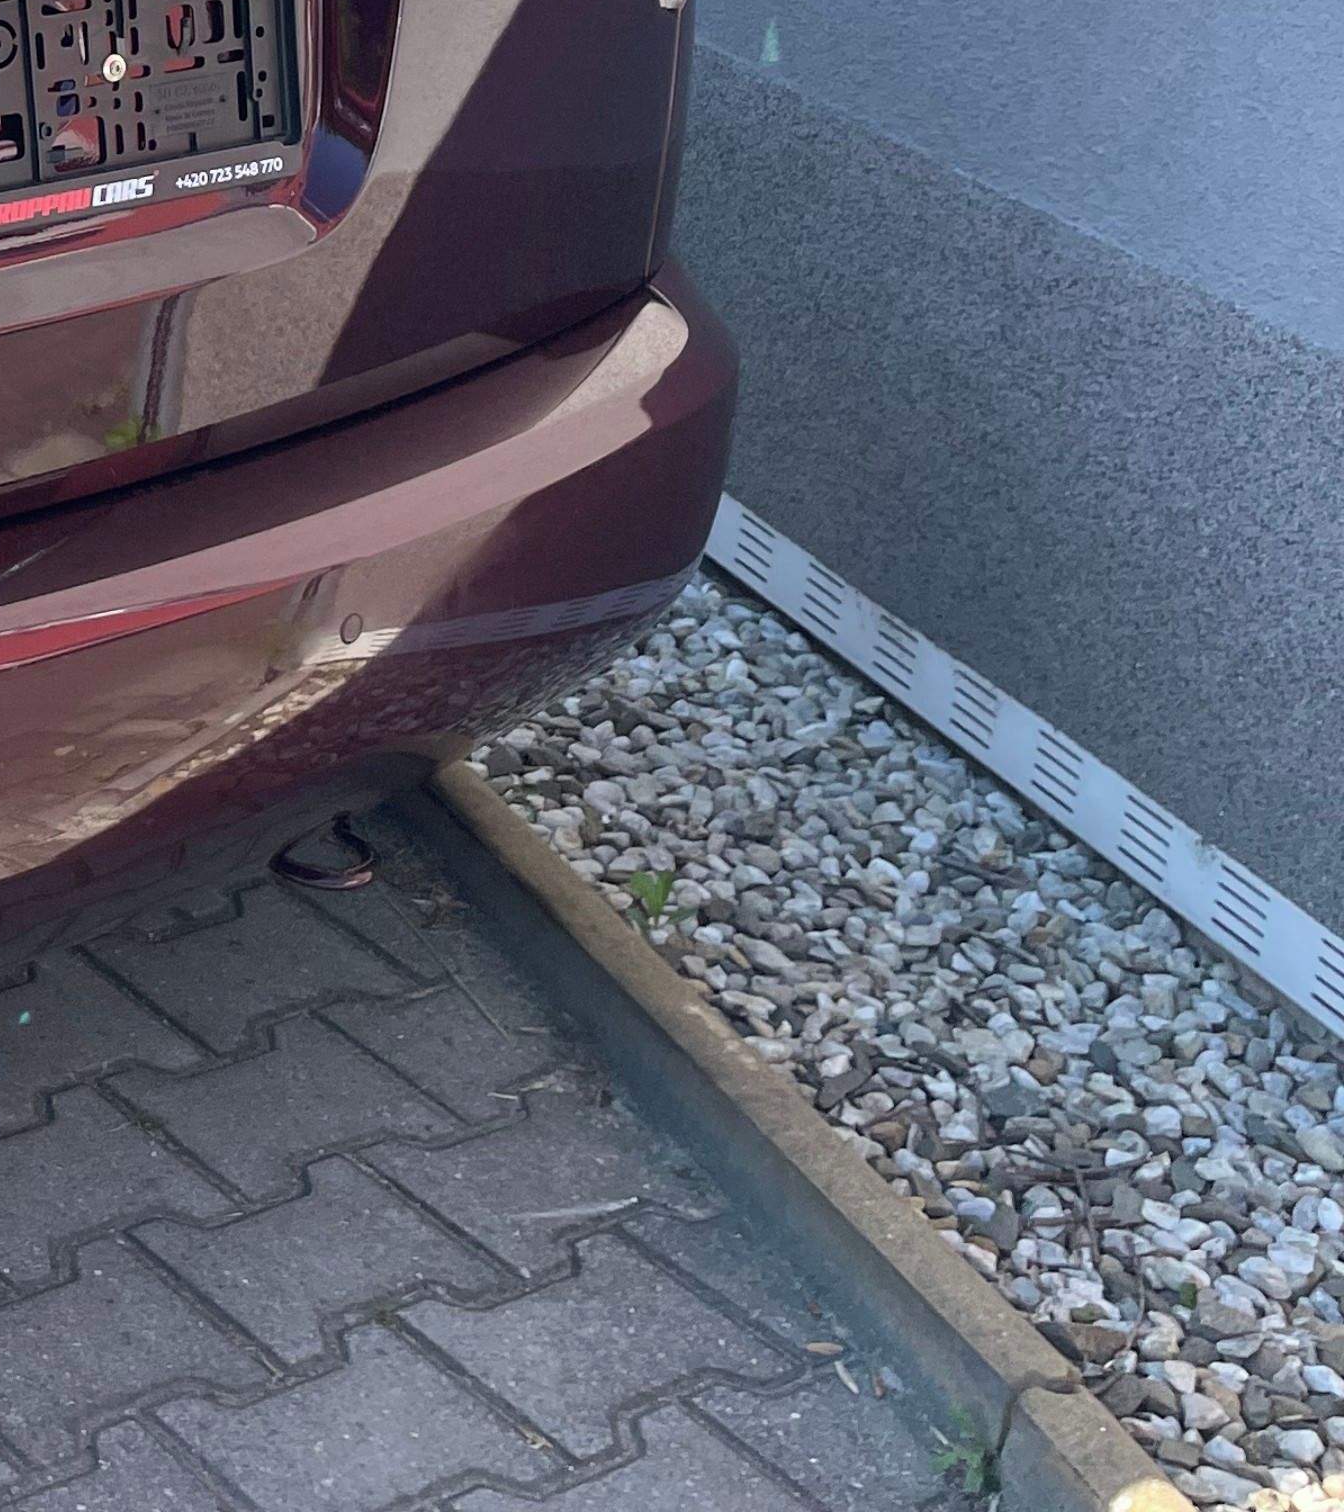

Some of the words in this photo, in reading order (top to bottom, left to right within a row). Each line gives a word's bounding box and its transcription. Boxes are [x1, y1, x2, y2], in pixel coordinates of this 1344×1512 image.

[175, 171, 208, 189] +420
[210, 166, 232, 183] 723
[234, 161, 259, 179] 548
[260, 157, 283, 174] 770
